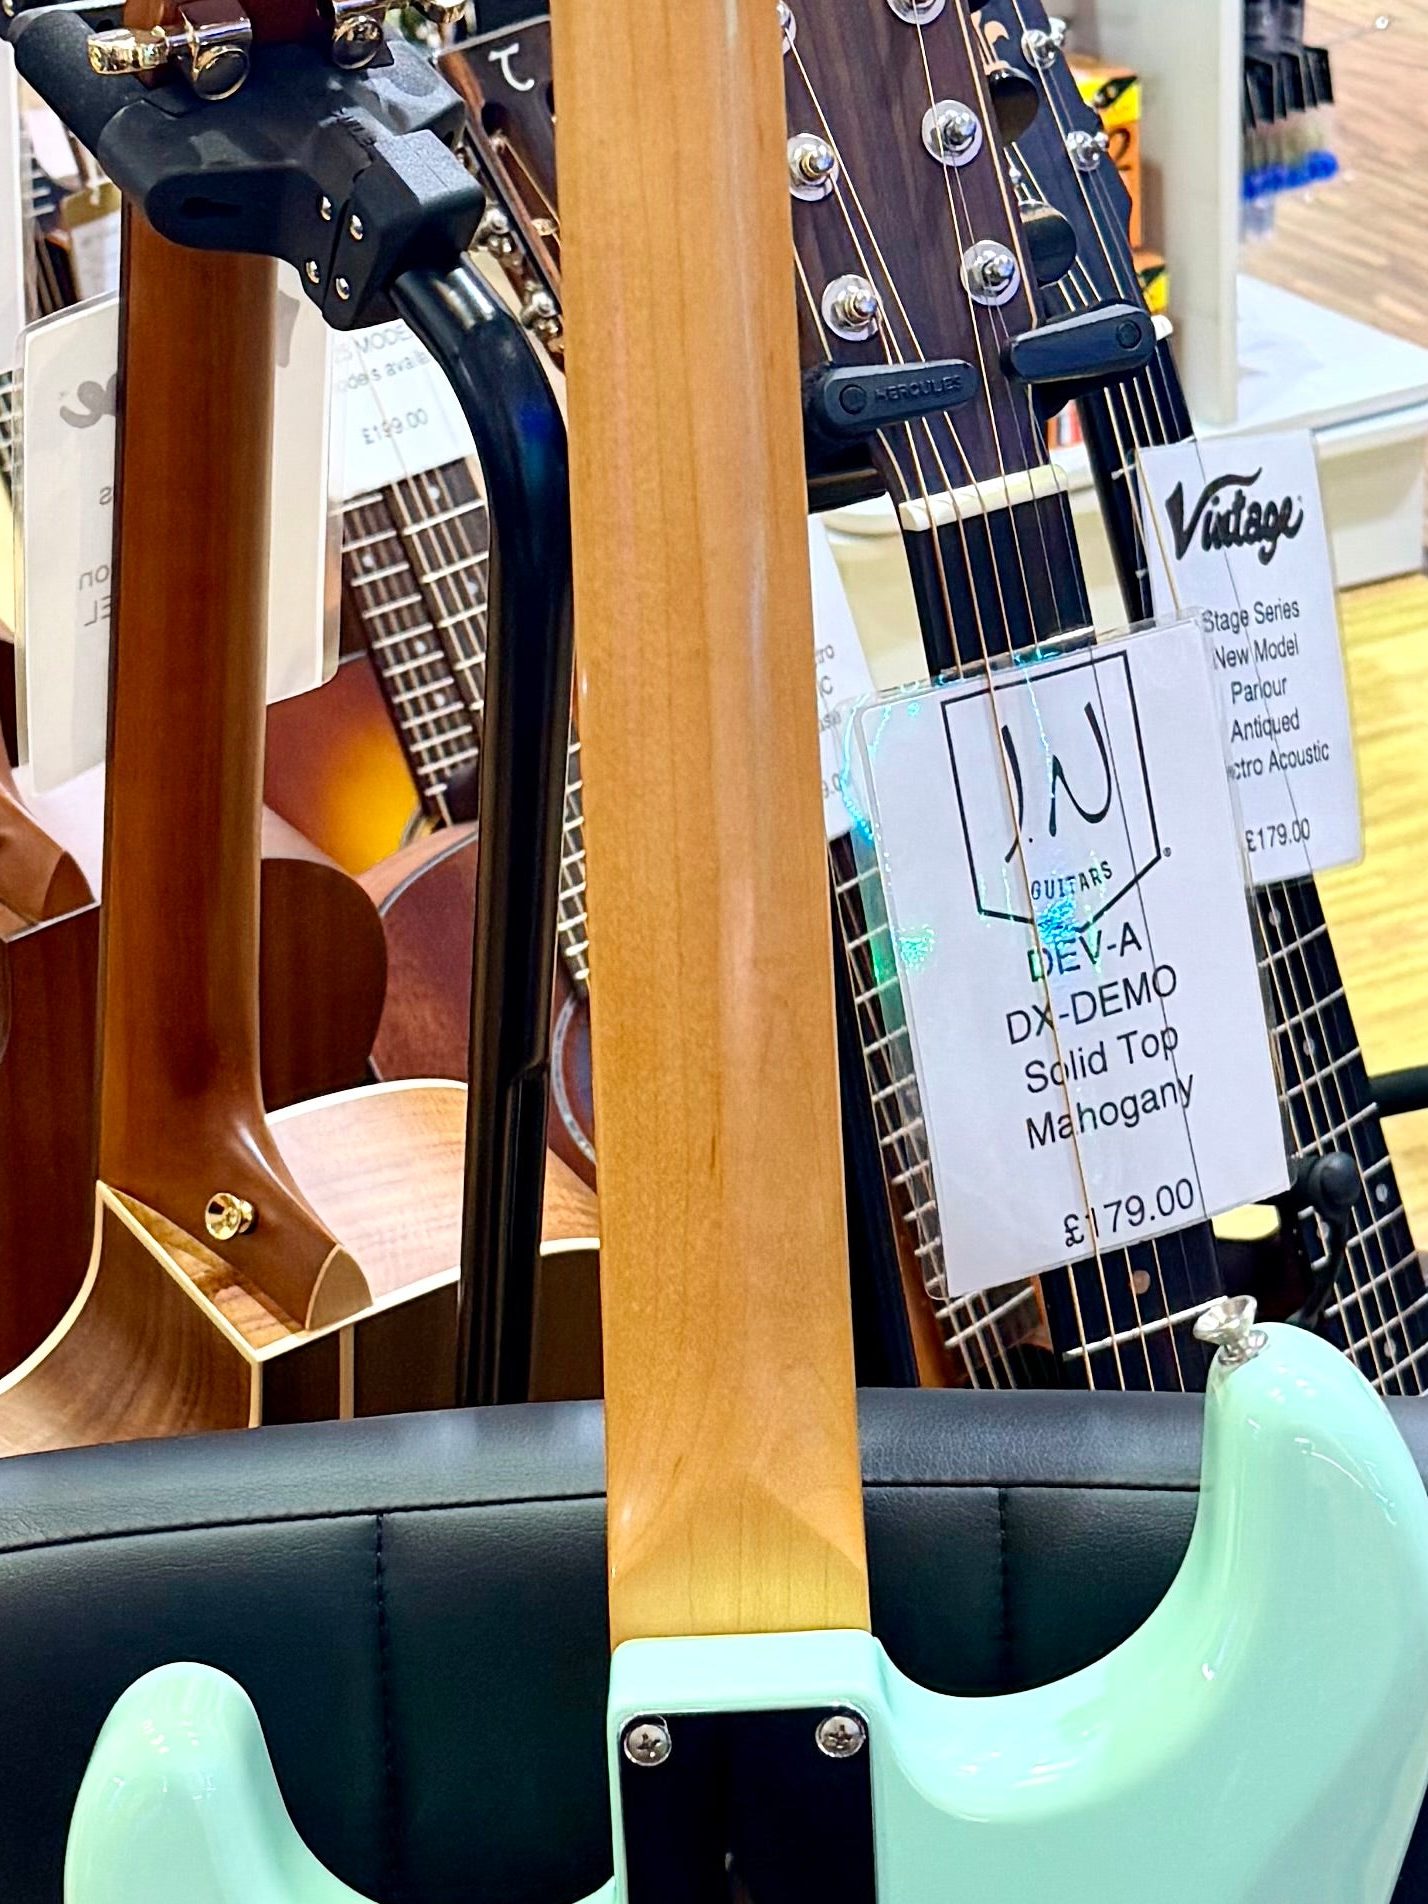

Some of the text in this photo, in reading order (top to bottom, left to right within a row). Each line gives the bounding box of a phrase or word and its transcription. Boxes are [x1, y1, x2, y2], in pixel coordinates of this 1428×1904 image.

[875, 374, 962, 401] HERCULES
[1165, 467, 1305, 565] Vintage
[1203, 598, 1301, 635] Stage Series
[1213, 633, 1300, 671] New Model
[1230, 674, 1287, 704] Parlour
[1230, 709, 1301, 744] Antiqued
[1269, 739, 1330, 771] Acoustic
[1245, 817, 1312, 853] £179.00
[1029, 860, 1114, 901] GUITARS
[1027, 921, 1143, 985] DEV-A
[1006, 962, 1178, 1046] DX-DEMO
[1024, 1024, 1181, 1095] Solid Top
[1026, 1072, 1195, 1150] Mahogany
[1063, 1177, 1196, 1247] £179.00
